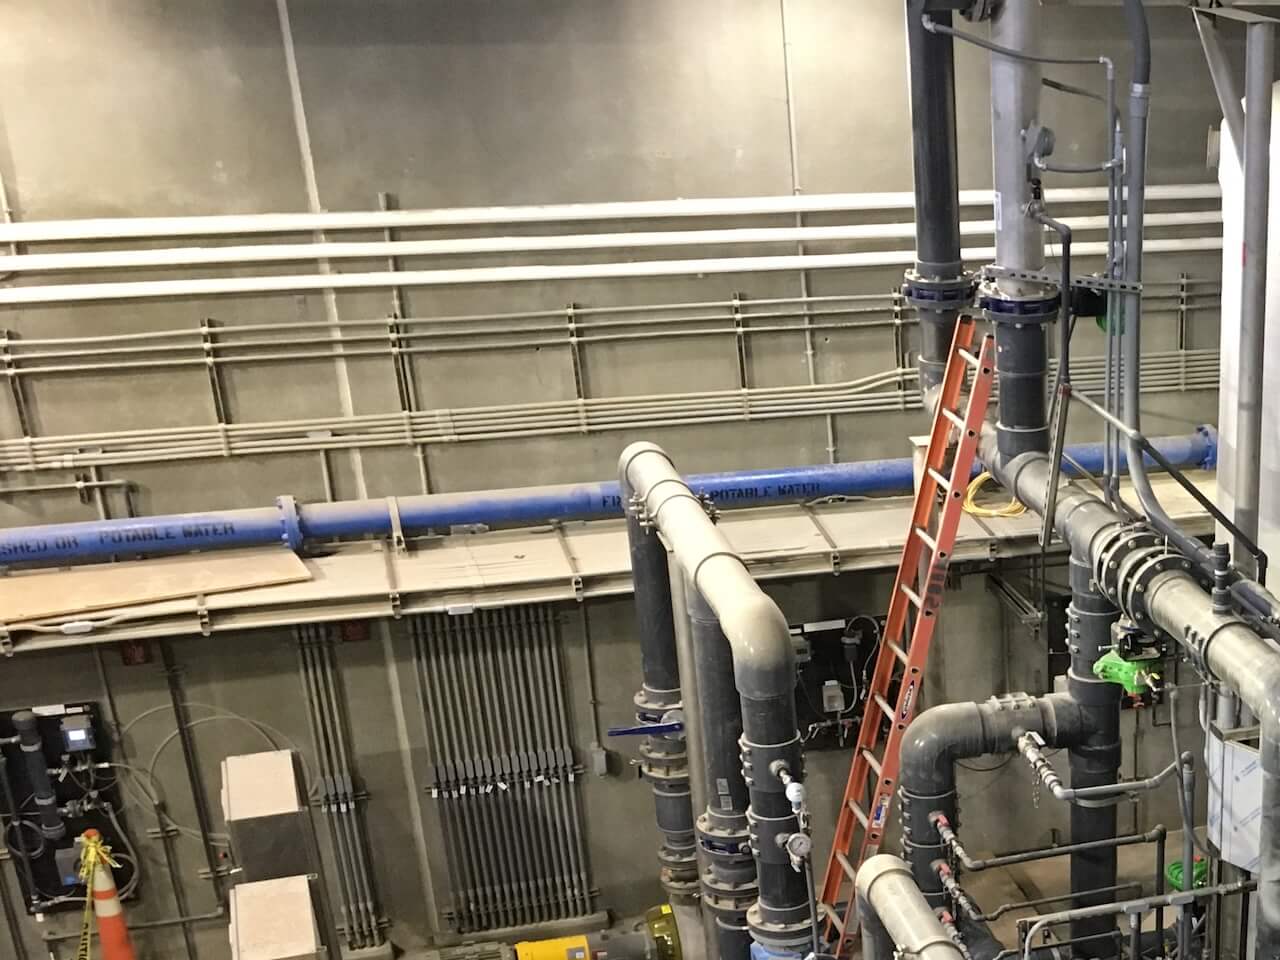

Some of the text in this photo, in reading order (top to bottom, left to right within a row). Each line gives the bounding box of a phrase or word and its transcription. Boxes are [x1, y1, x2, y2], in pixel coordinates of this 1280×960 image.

[710, 486, 772, 501] POTABLE
[778, 483, 820, 497] WATER
[56, 535, 79, 550] OR
[100, 526, 176, 545] POTABLE
[182, 521, 236, 538] WATER
